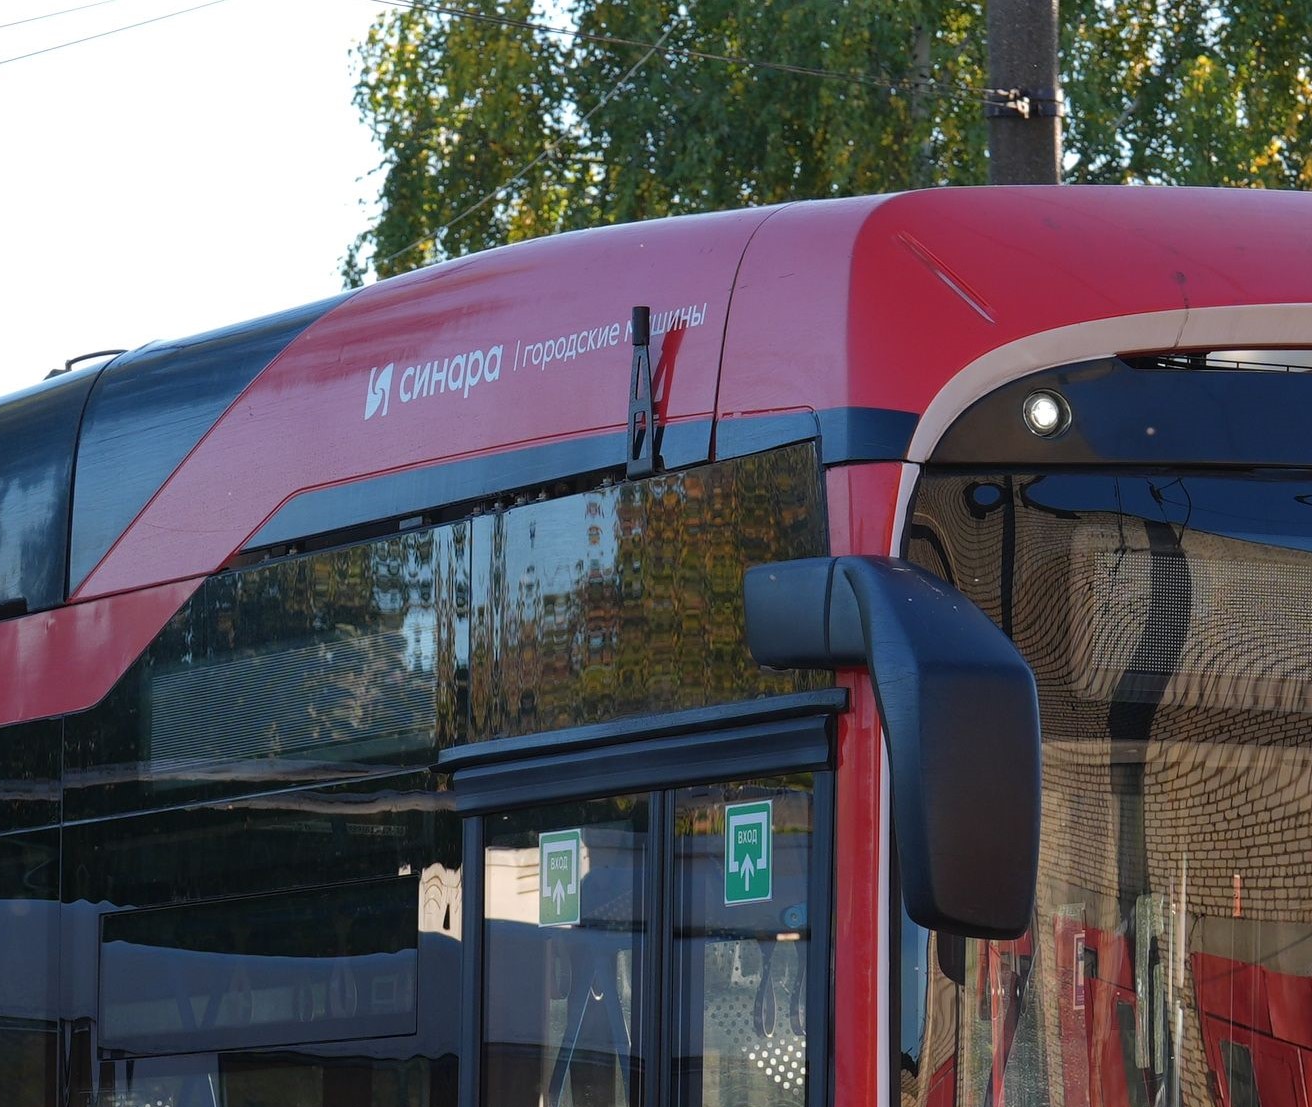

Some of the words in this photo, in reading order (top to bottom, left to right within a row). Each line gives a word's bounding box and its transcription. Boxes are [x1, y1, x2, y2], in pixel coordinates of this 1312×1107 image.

[399, 344, 503, 402] синара
[522, 321, 620, 371] городские
[624, 302, 708, 343] мшины
[738, 829, 758, 845] ВХОД
[550, 856, 568, 870] ВХОД
